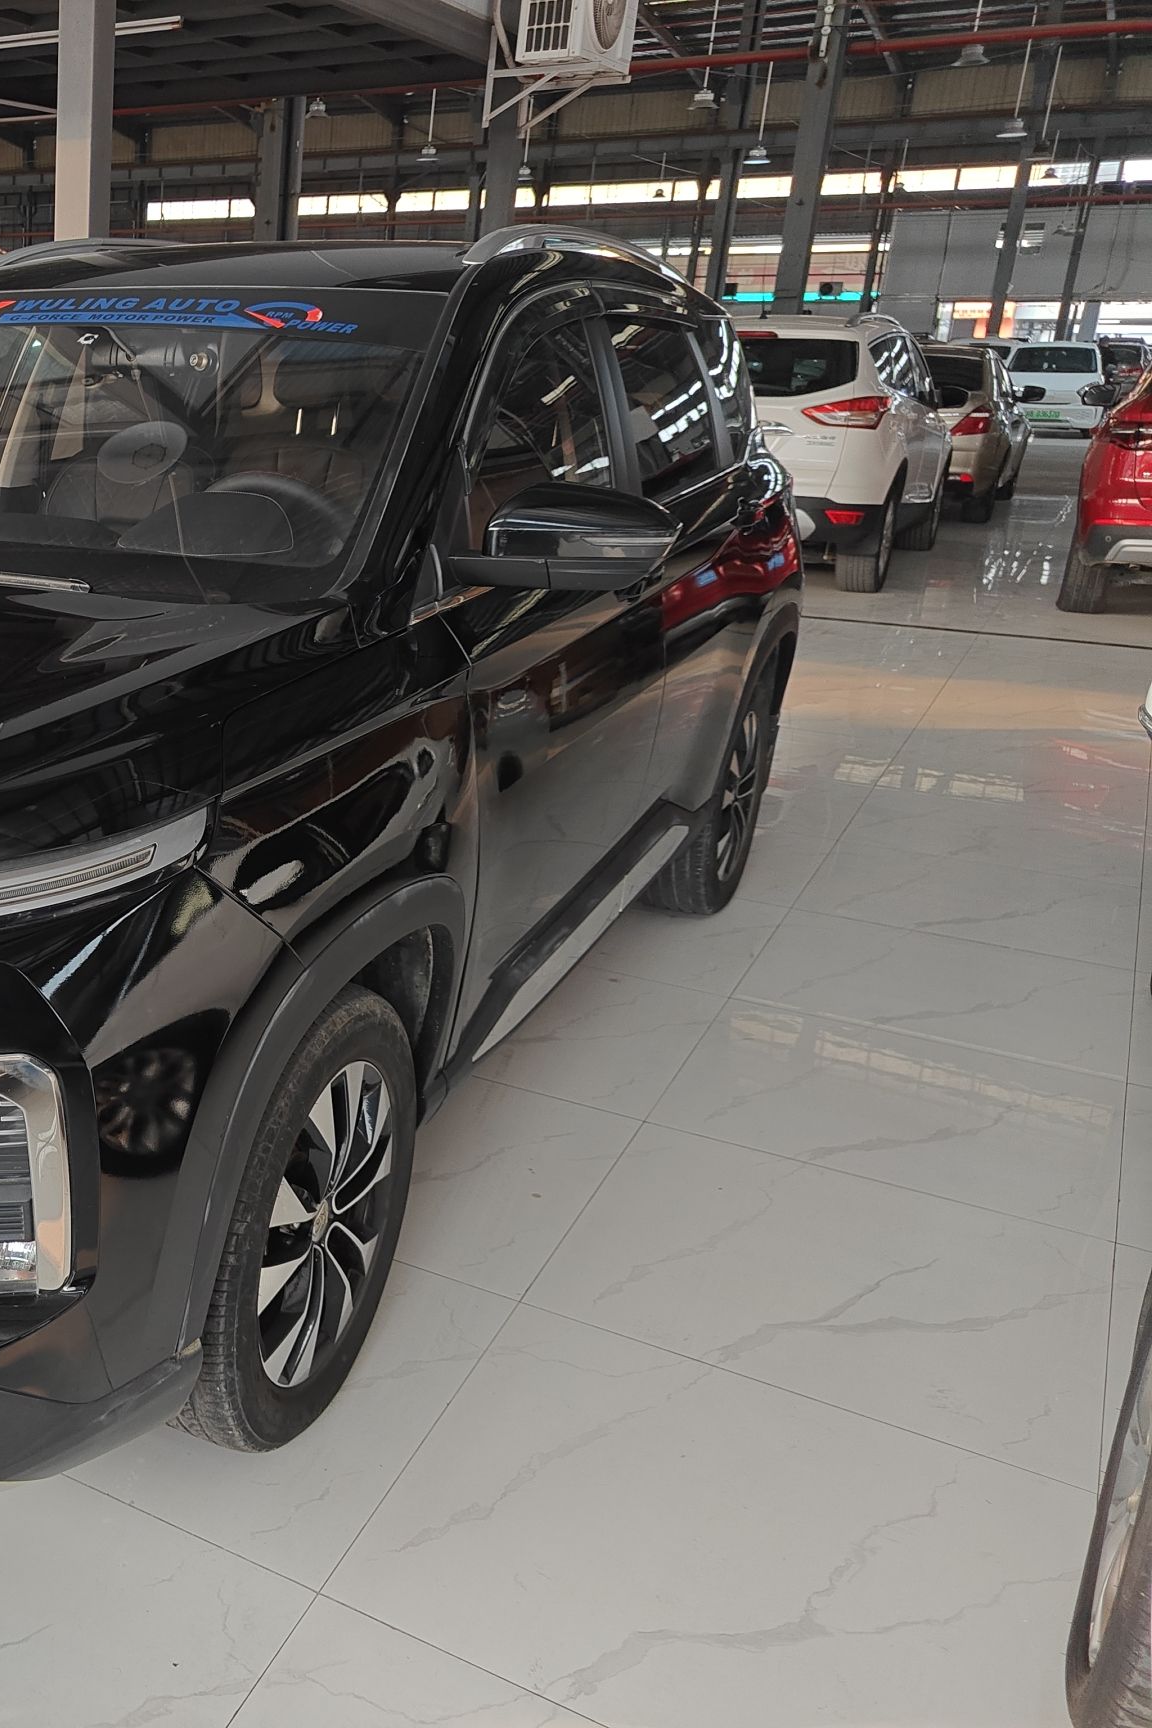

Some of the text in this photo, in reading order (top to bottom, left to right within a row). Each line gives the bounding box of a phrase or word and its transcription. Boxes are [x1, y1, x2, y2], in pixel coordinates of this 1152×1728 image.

[12, 297, 241, 312] WULING AUTO
[10, 312, 216, 324] G-FORCE MOTOR POWER
[265, 310, 295, 319] RPM
